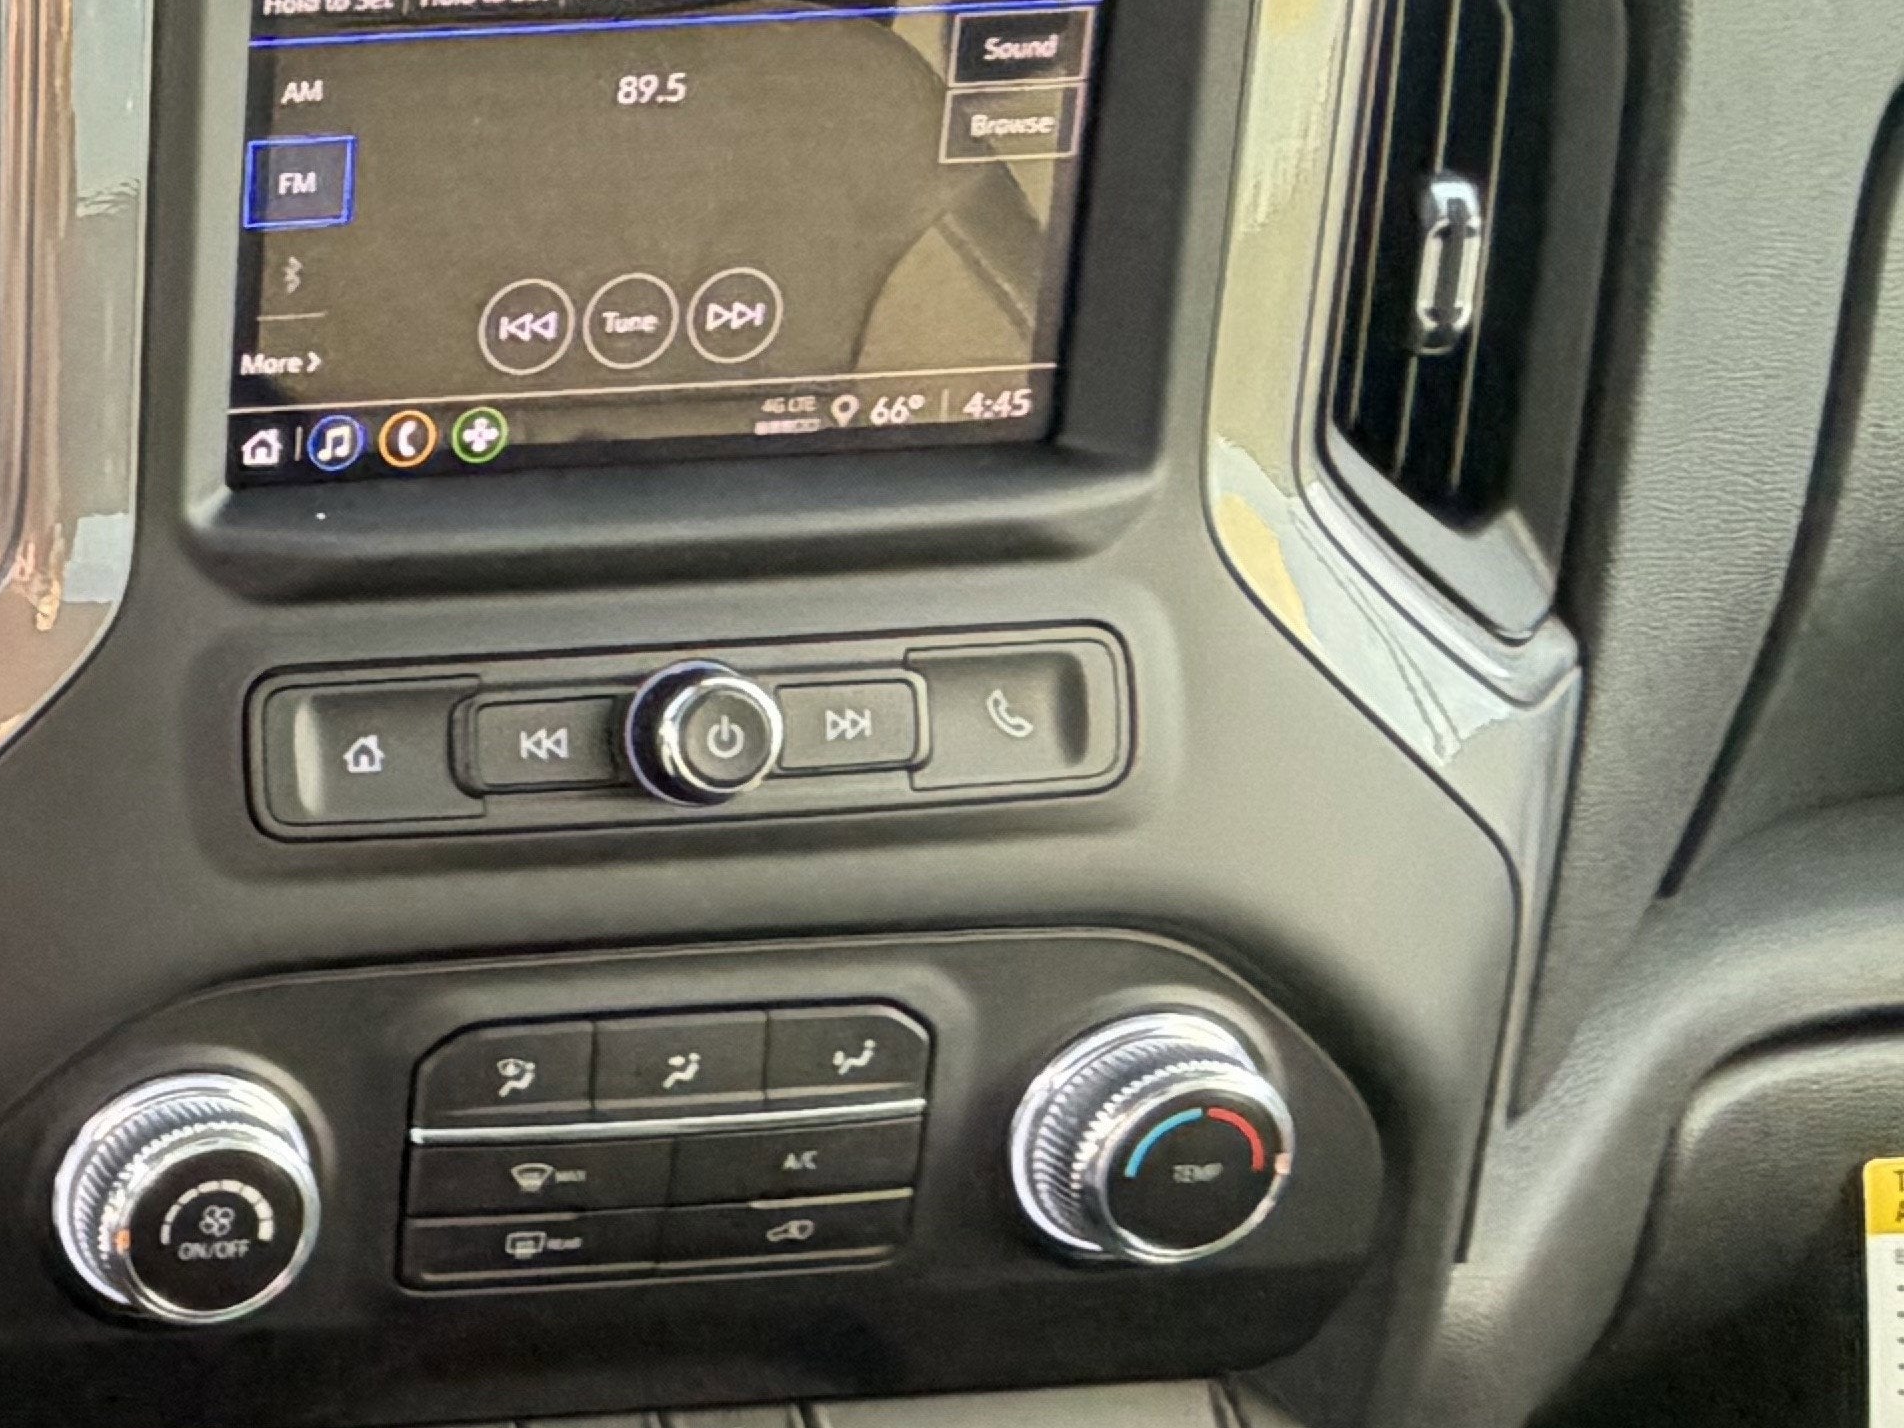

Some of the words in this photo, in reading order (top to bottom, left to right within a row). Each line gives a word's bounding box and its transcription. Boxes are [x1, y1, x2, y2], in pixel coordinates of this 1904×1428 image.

[984, 34, 1058, 60] Sound
[281, 80, 323, 104] AM
[617, 73, 687, 104] 89.5
[971, 113, 1056, 138] Browse
[278, 172, 317, 195] FM
[602, 311, 659, 333] Tune
[240, 352, 303, 375] More
[962, 388, 1032, 418] 4:45
[177, 1239, 251, 1261] ON/OFF
